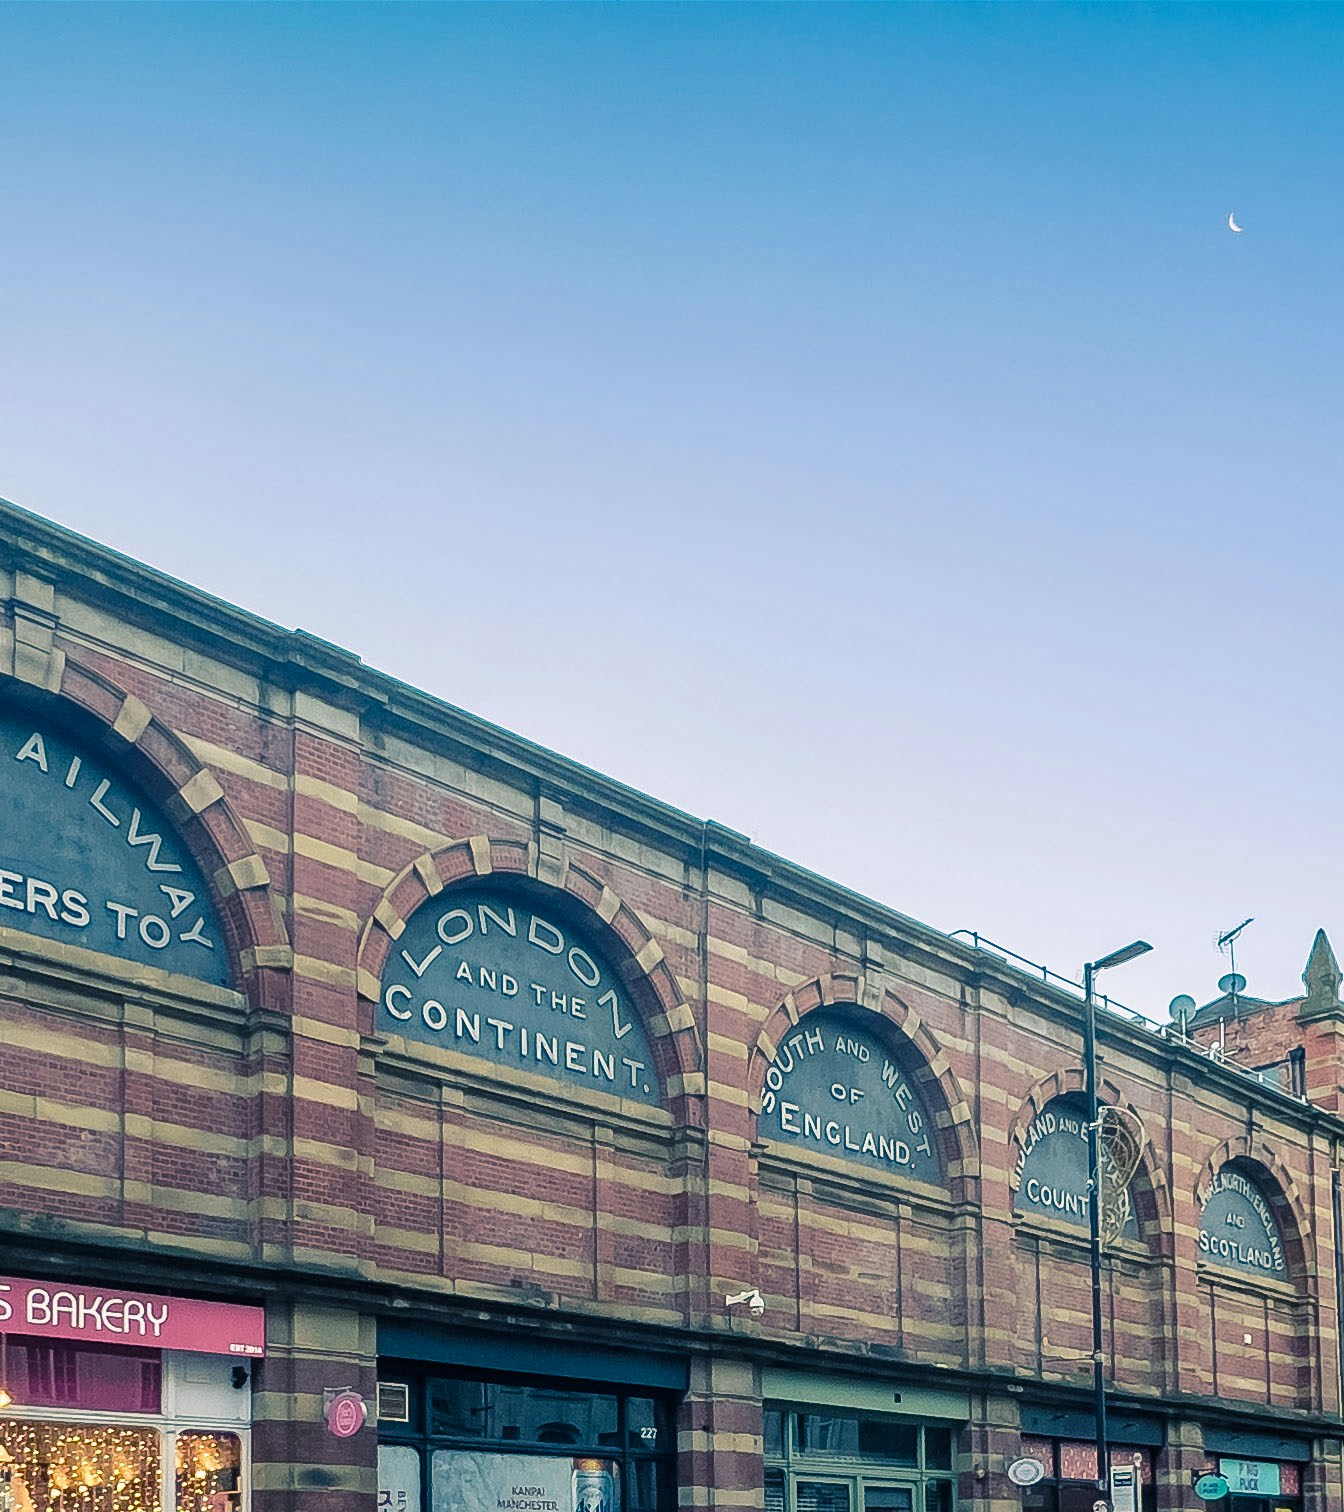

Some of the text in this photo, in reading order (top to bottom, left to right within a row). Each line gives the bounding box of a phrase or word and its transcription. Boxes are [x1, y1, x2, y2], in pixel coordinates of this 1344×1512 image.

[106, 901, 172, 949] TO
[401, 904, 633, 1039] LONDON
[456, 961, 587, 1020] AND THE
[384, 983, 651, 1094] CONTINENT.
[761, 1026, 932, 1158] SOUTH AND WEST
[830, 1081, 865, 1104] OF
[779, 1101, 917, 1170] ENGLAND.
[1059, 1117, 1079, 1135] AND
[25, 1288, 169, 1337] BAKERY
[640, 1427, 658, 1440] 227
[511, 1485, 546, 1497] KANPAI
